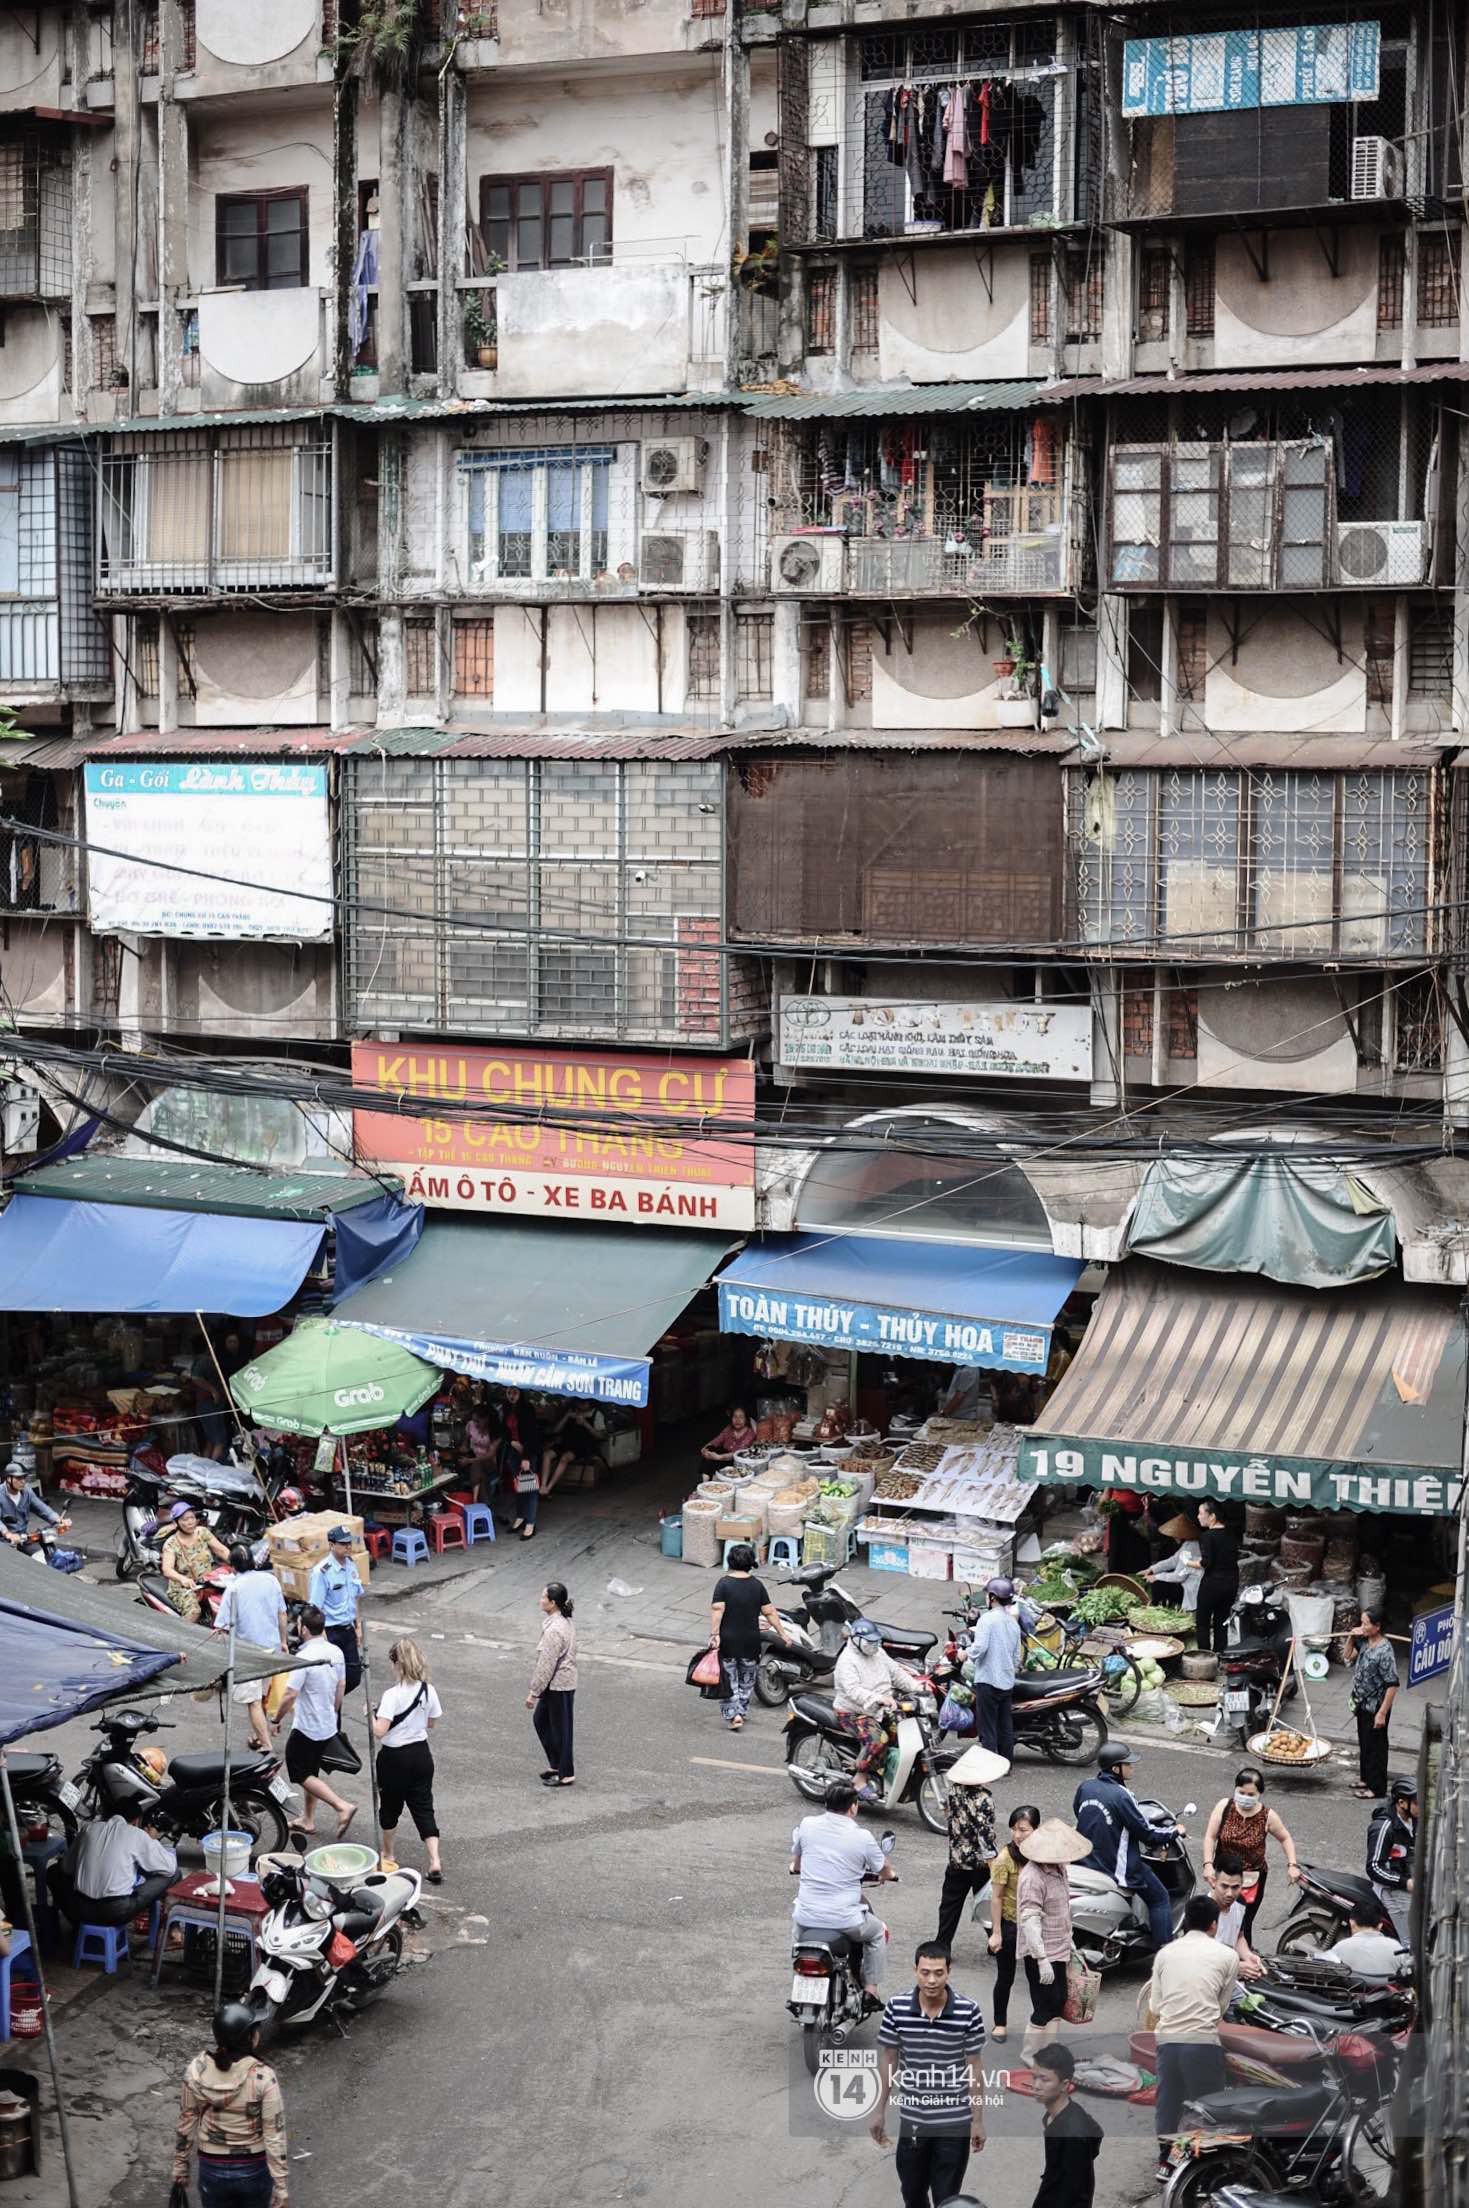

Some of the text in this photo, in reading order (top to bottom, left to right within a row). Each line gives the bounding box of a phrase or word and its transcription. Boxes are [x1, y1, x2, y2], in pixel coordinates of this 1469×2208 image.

[378, 1056, 728, 1116] KHU CHUNG CƯ
[420, 1117, 453, 1145] 15
[457, 1173, 476, 1200] Ô
[480, 1177, 517, 1203] TÔ
[544, 1185, 580, 1208] XE
[590, 1188, 627, 1212] BA
[637, 1186, 718, 1218] BÁNH
[726, 1293, 788, 1325] TOÀN
[944, 1323, 994, 1354] HOA
[334, 1382, 384, 1408] Grab
[597, 1376, 642, 1402] TRANG
[276, 1416, 302, 1430] Grab
[1029, 1449, 1084, 1478] 19
[1101, 1453, 1312, 1500] NGUYỄN
